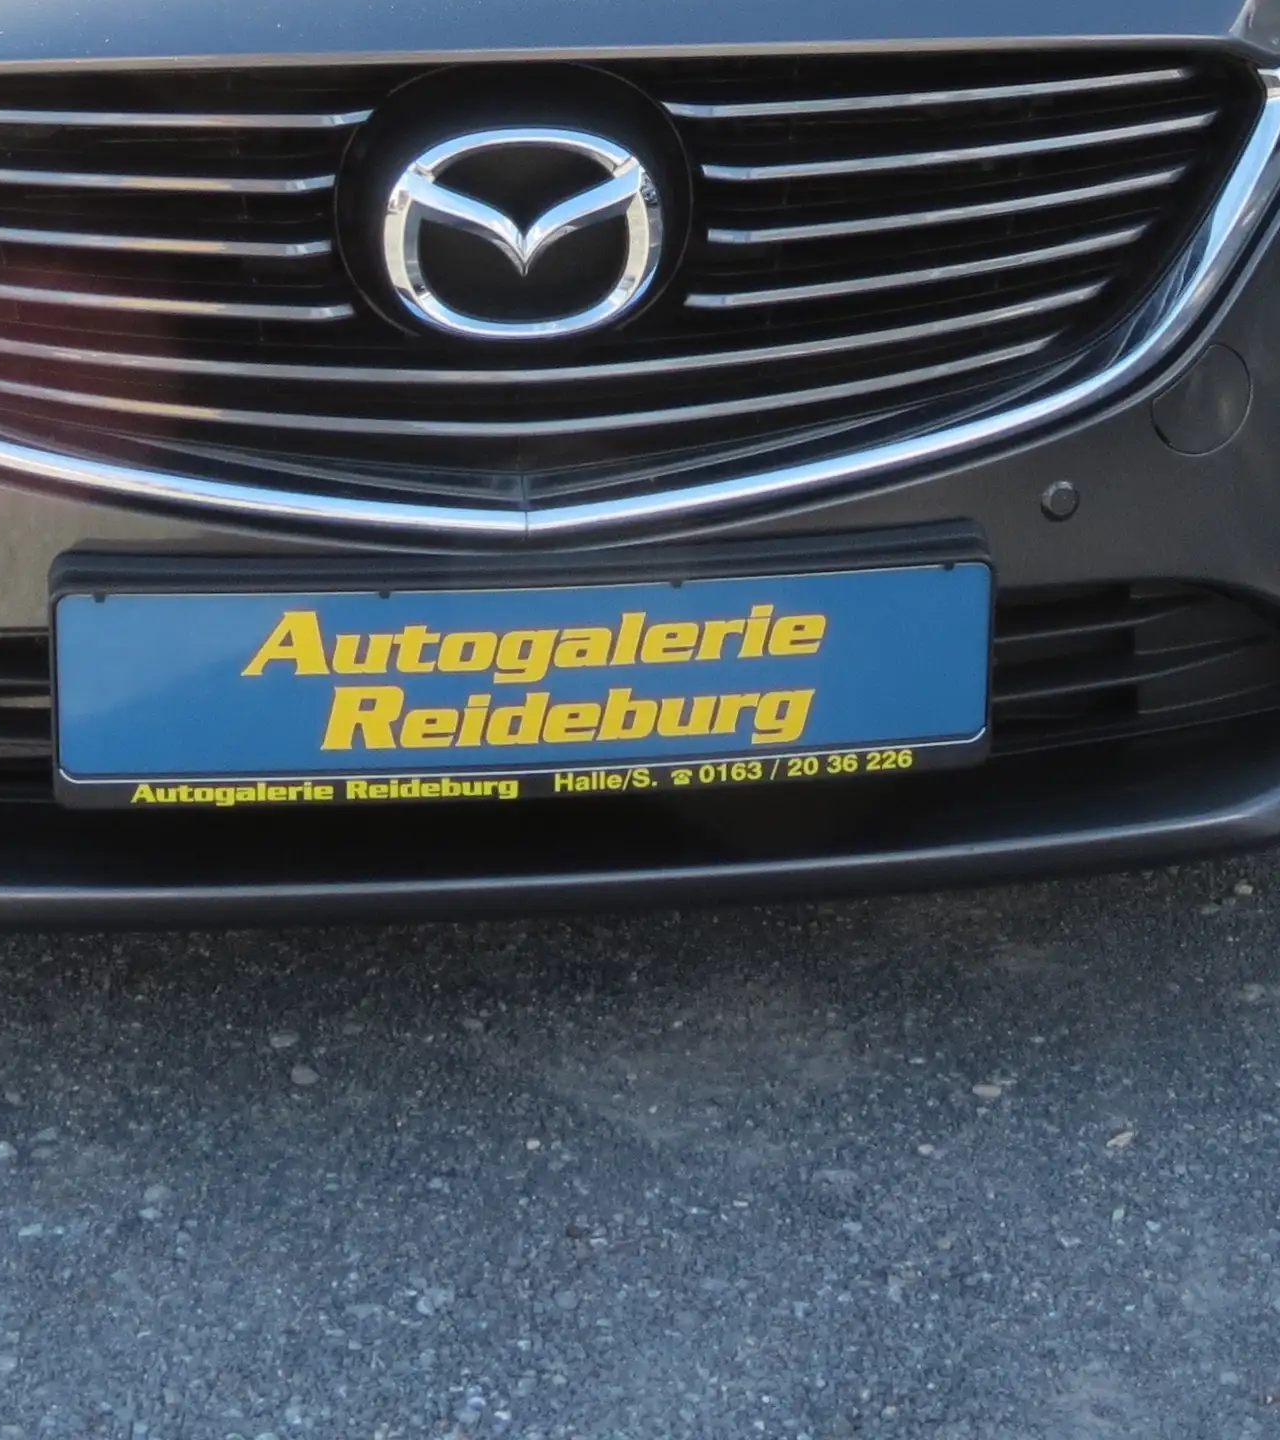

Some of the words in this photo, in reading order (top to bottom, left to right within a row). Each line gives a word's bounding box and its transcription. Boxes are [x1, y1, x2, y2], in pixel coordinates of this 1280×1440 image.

[241, 605, 827, 683] Autogalerie
[321, 686, 815, 750] Reideburg
[131, 782, 334, 806] Autogalerie
[346, 777, 519, 800] Reideburg
[554, 768, 658, 792] Halle/S.
[699, 762, 763, 783] 0163
[787, 757, 819, 777] 20
[827, 754, 858, 774] 36
[866, 749, 913, 771] 226
